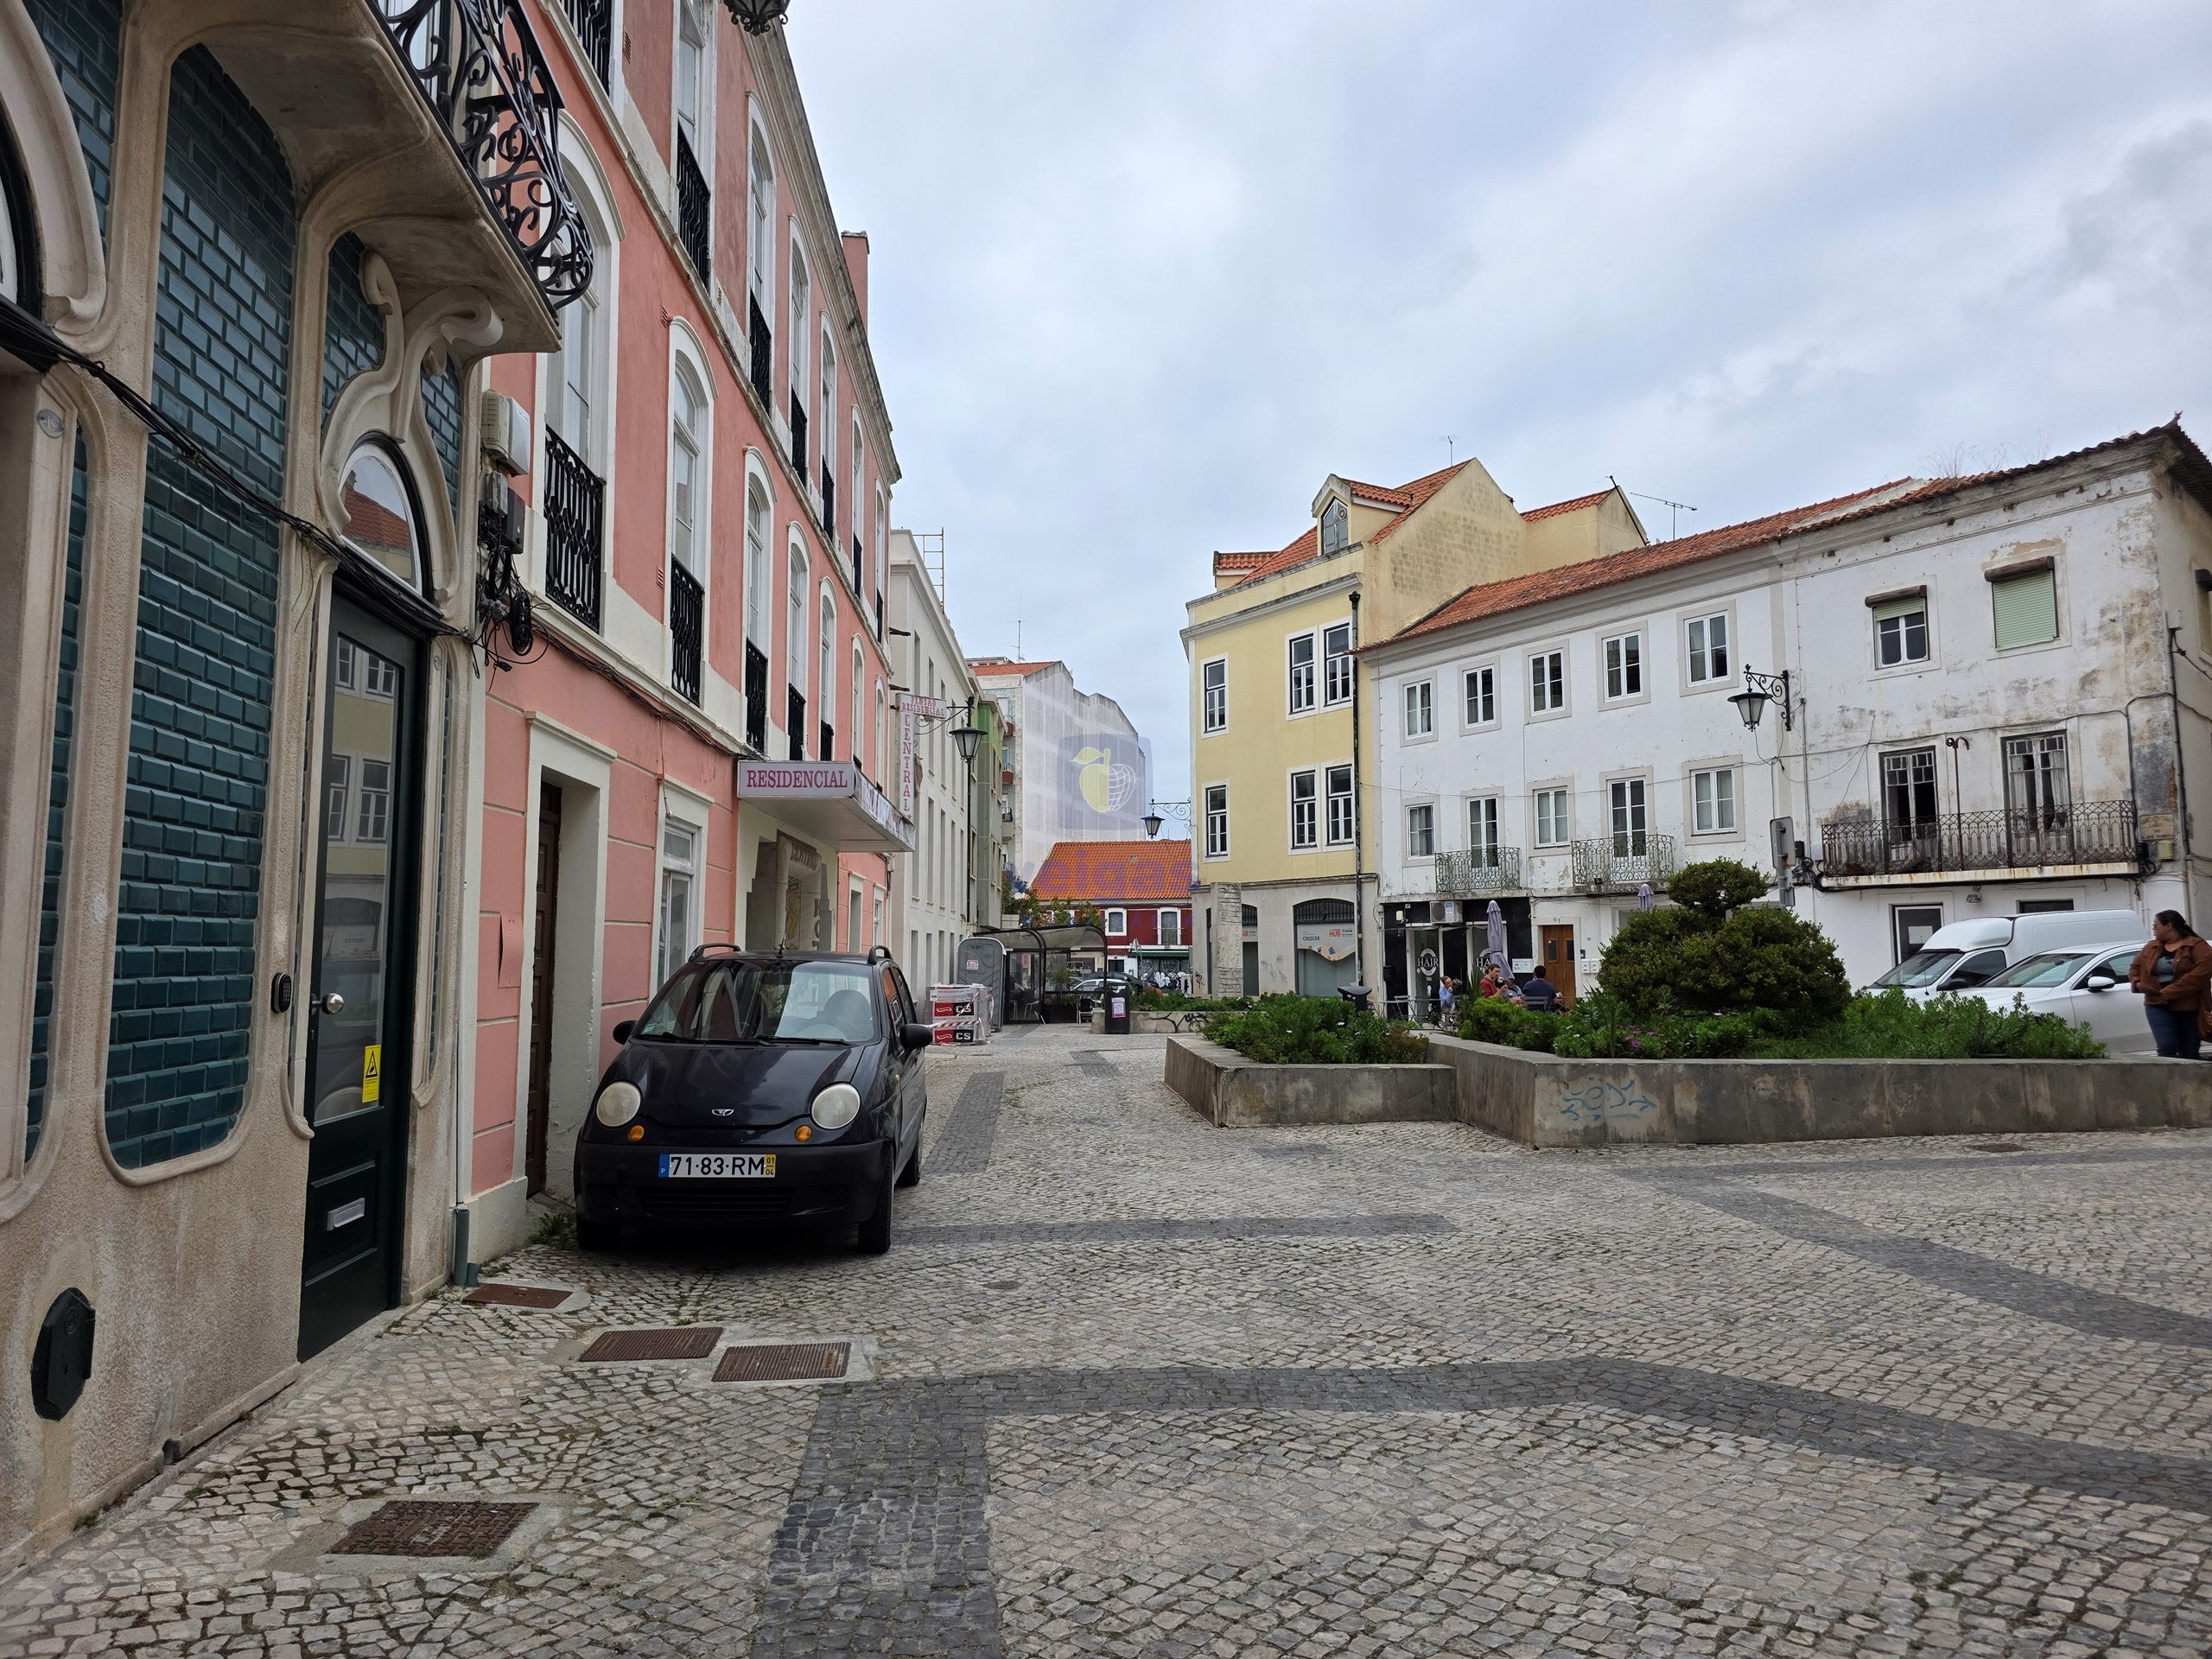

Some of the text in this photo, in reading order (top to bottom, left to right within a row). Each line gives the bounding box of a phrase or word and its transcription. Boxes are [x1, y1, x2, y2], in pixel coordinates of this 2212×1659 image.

[901, 702, 945, 716] RESIDENCIAL
[902, 713, 912, 811] CENTRAL
[746, 769, 848, 789] RESIDENCIAL
[1417, 957, 1440, 967] HAIR
[1476, 957, 1491, 967] HA
